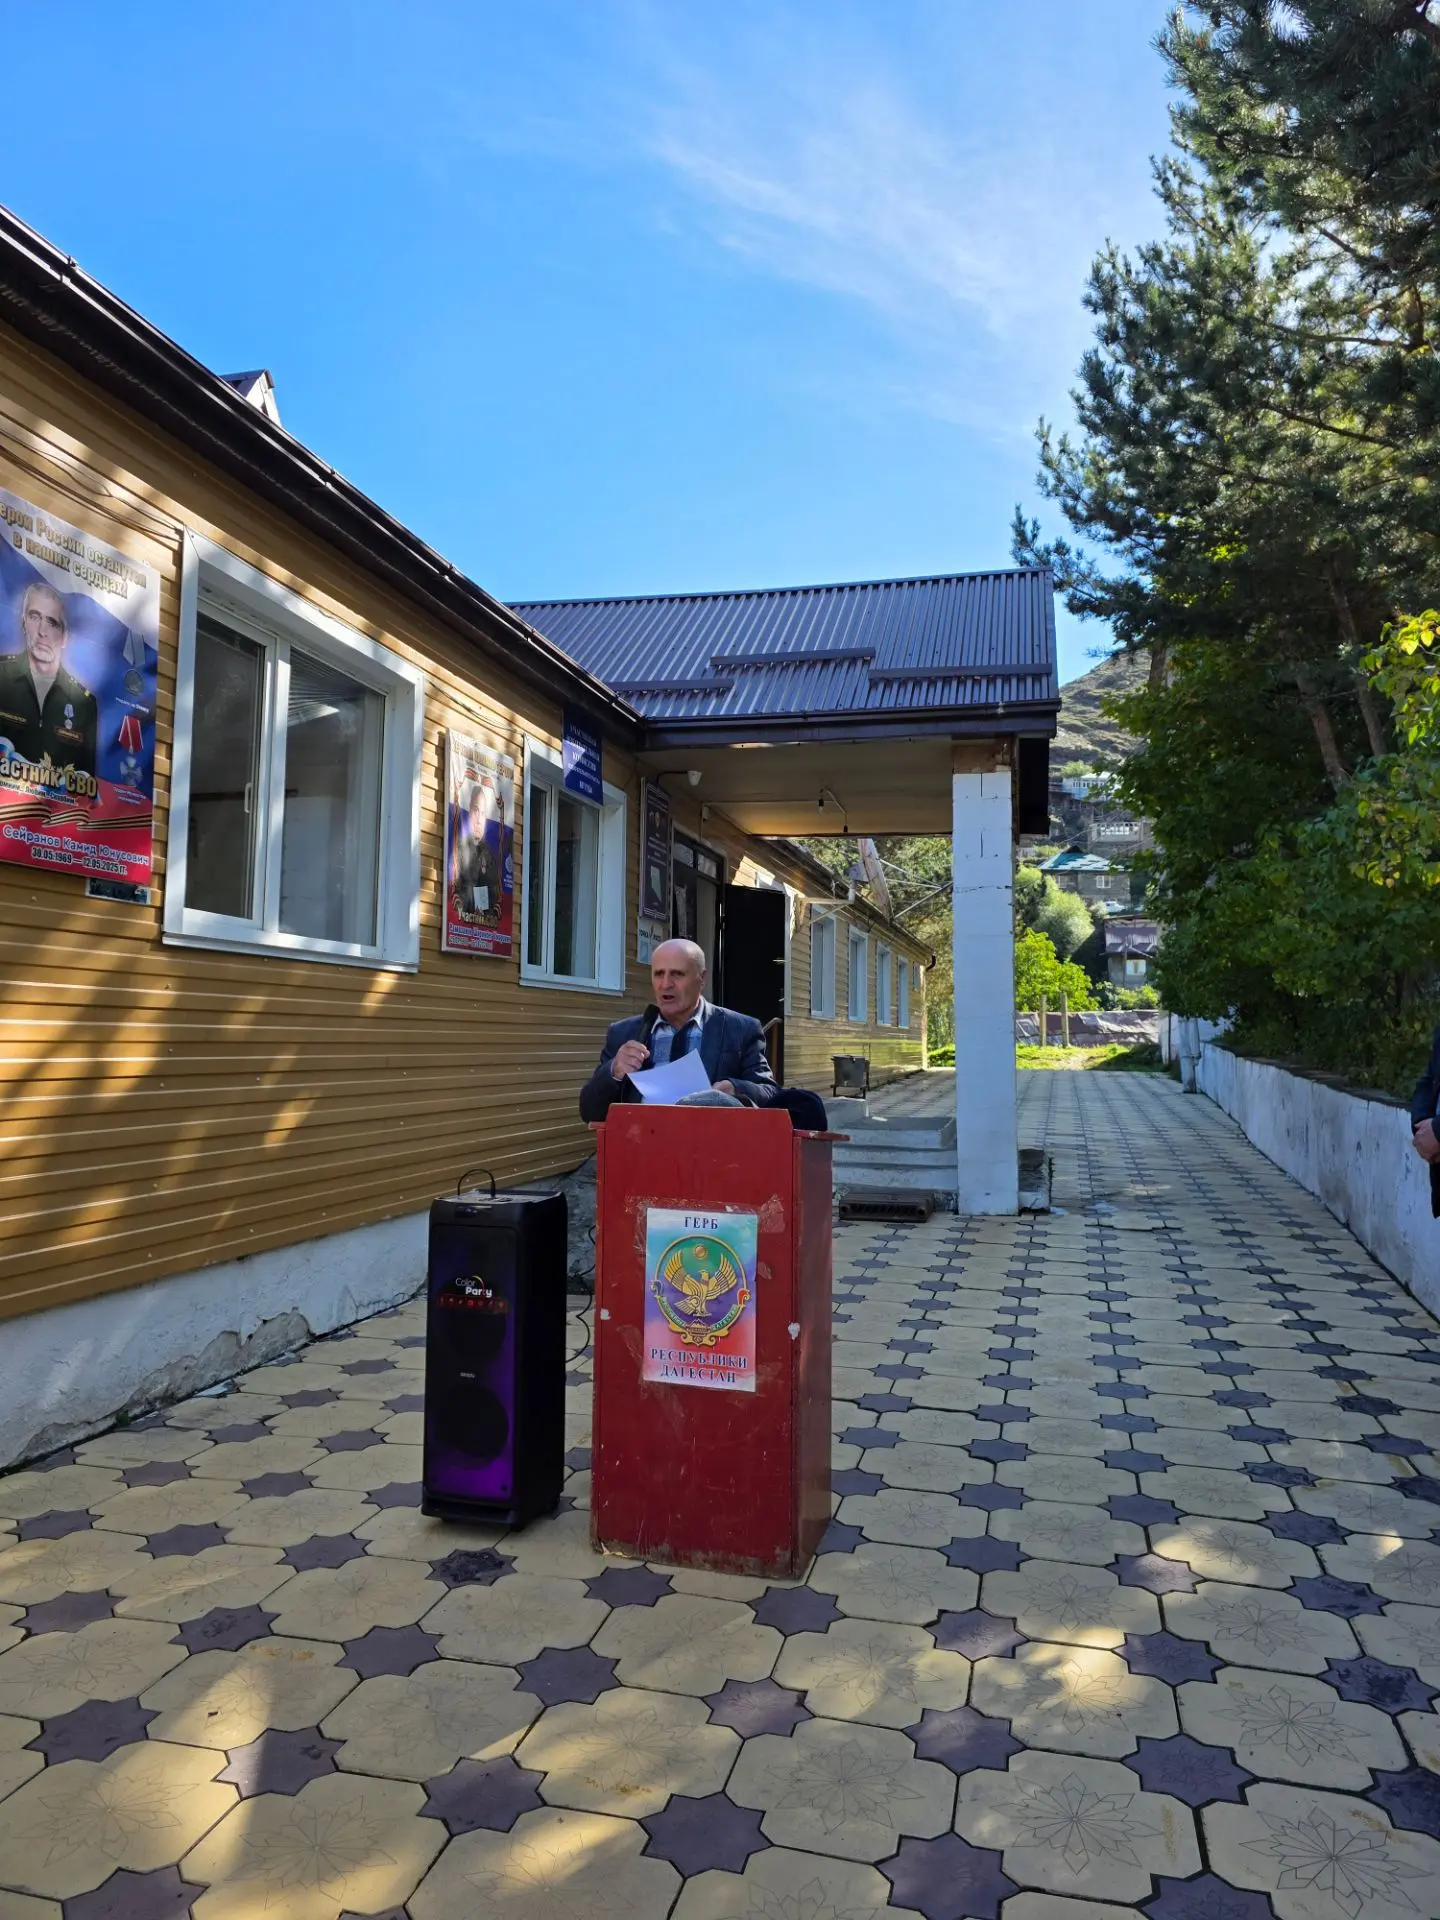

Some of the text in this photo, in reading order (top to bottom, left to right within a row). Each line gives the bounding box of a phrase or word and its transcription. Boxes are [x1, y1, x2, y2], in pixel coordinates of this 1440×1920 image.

[0, 502, 33, 532] ерои
[36, 517, 84, 558] России
[13, 531, 22, 549] в
[26, 537, 70, 572] наших
[0, 757, 60, 788] астник
[65, 769, 97, 797] СВО
[3, 825, 149, 865] Сейранов Камид Юнусович
[684, 1216, 718, 1229] ГЕРБ
[456, 1277, 475, 1287] Color
[465, 1286, 492, 1298] Party
[651, 1348, 748, 1369] РЕСПУБЛИКИ
[660, 1364, 736, 1383] ДАГЕСТАН
